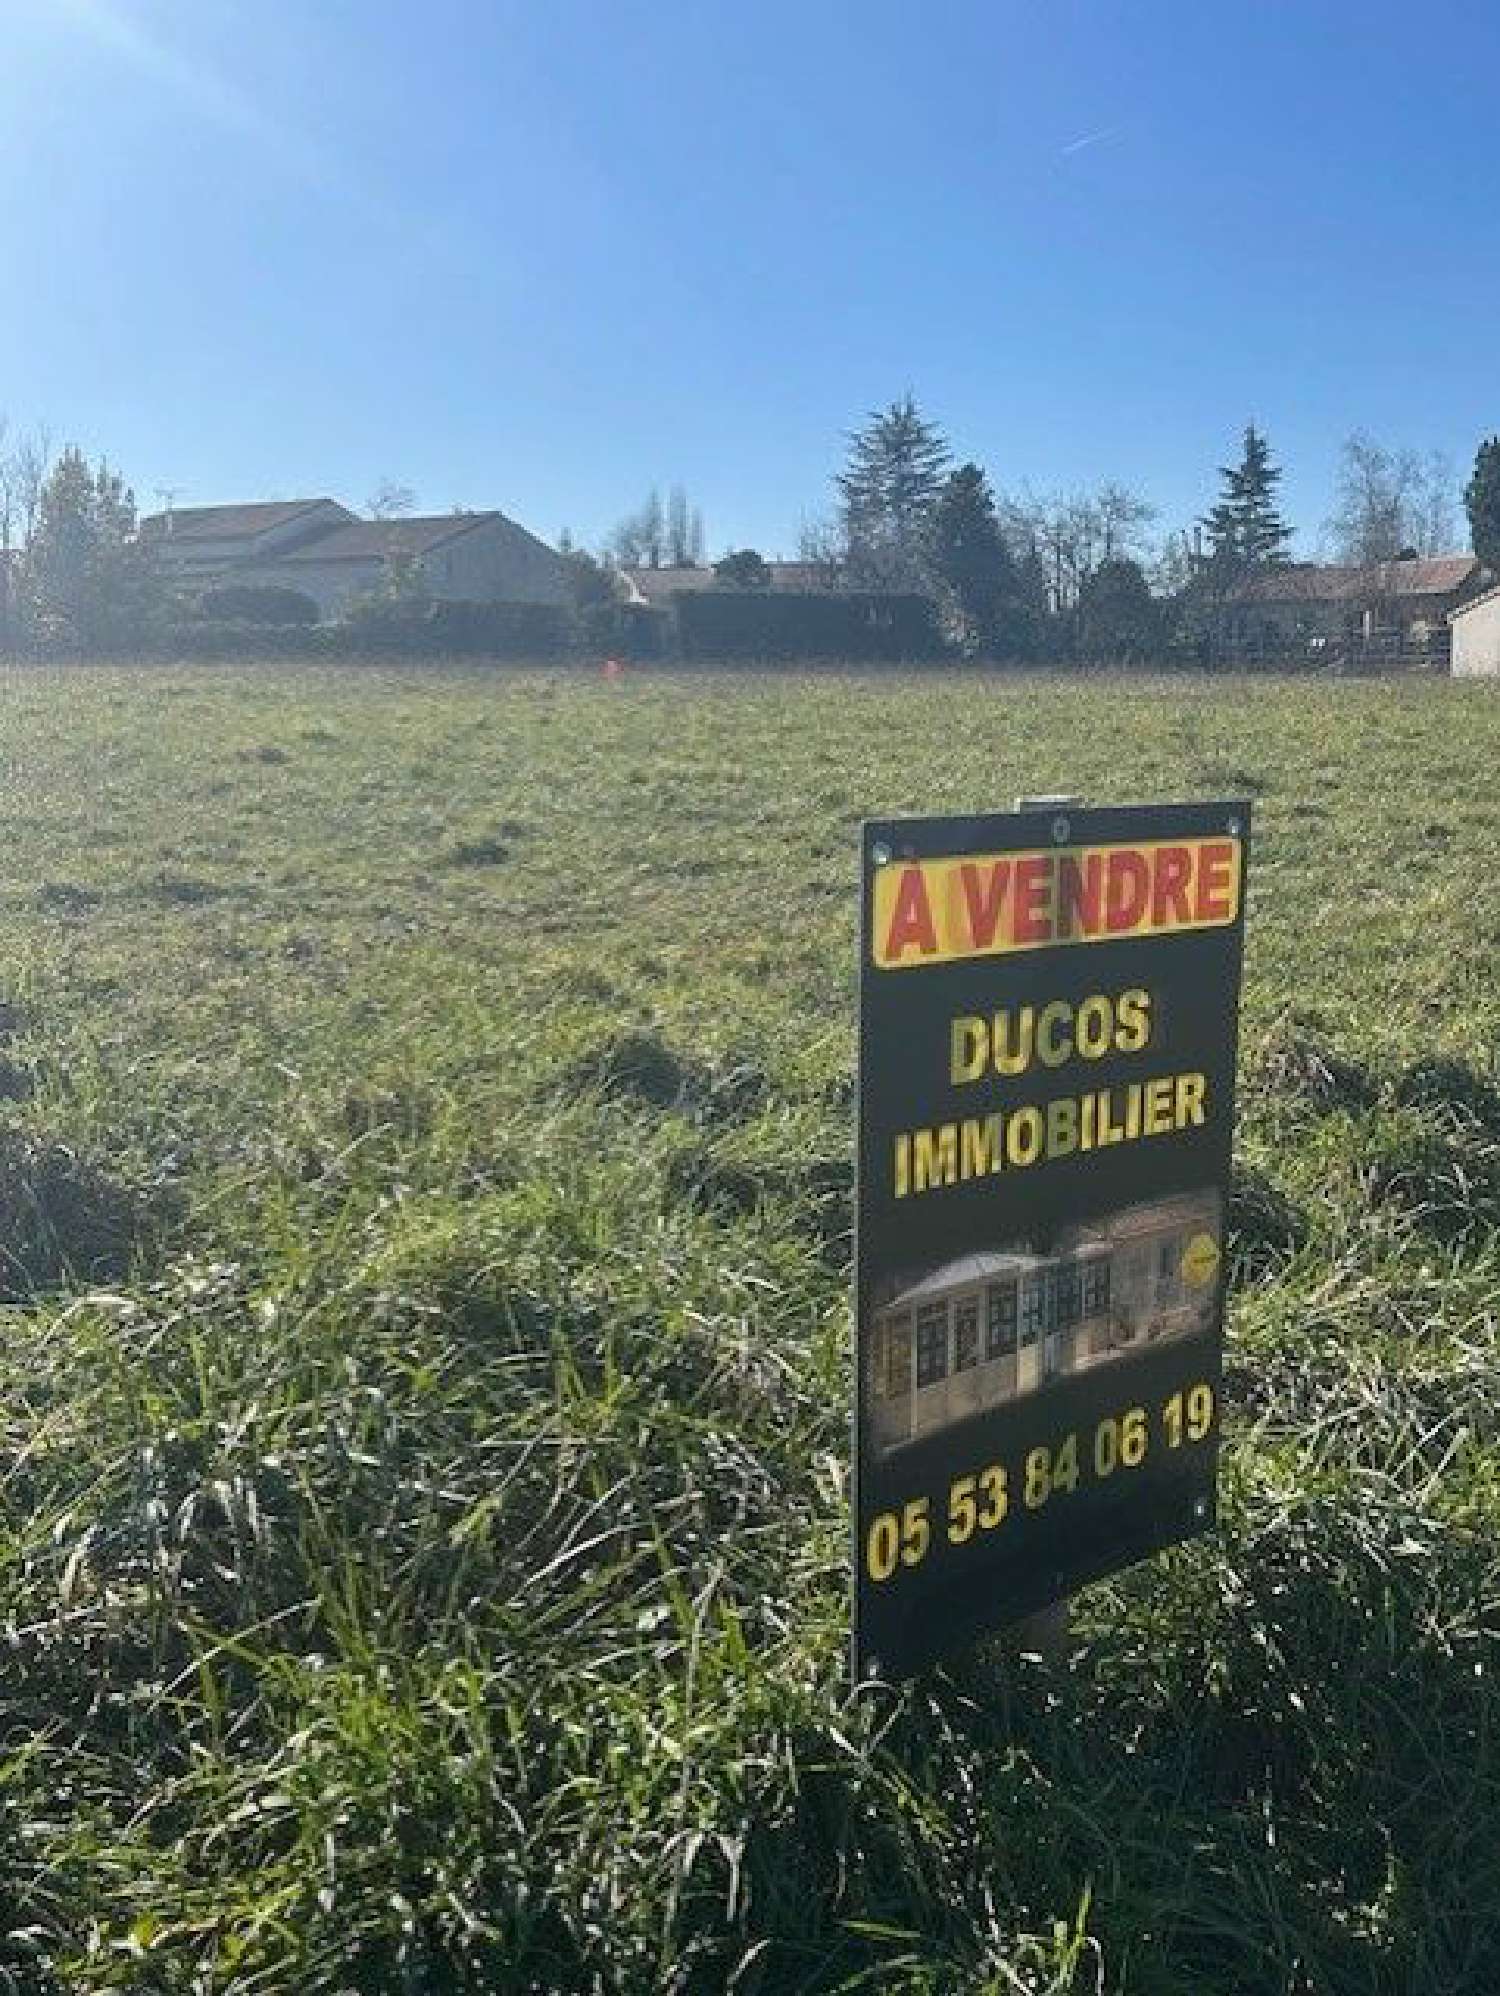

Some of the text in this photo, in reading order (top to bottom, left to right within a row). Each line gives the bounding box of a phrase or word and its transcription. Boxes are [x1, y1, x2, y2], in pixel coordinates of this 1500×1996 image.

[959, 843, 1234, 949] VENDRE
[951, 989, 1152, 1085] DUCOS
[894, 1073, 1206, 1199] IMMOBILIER
[866, 1384, 1215, 1582] 05 53 84 06 19
